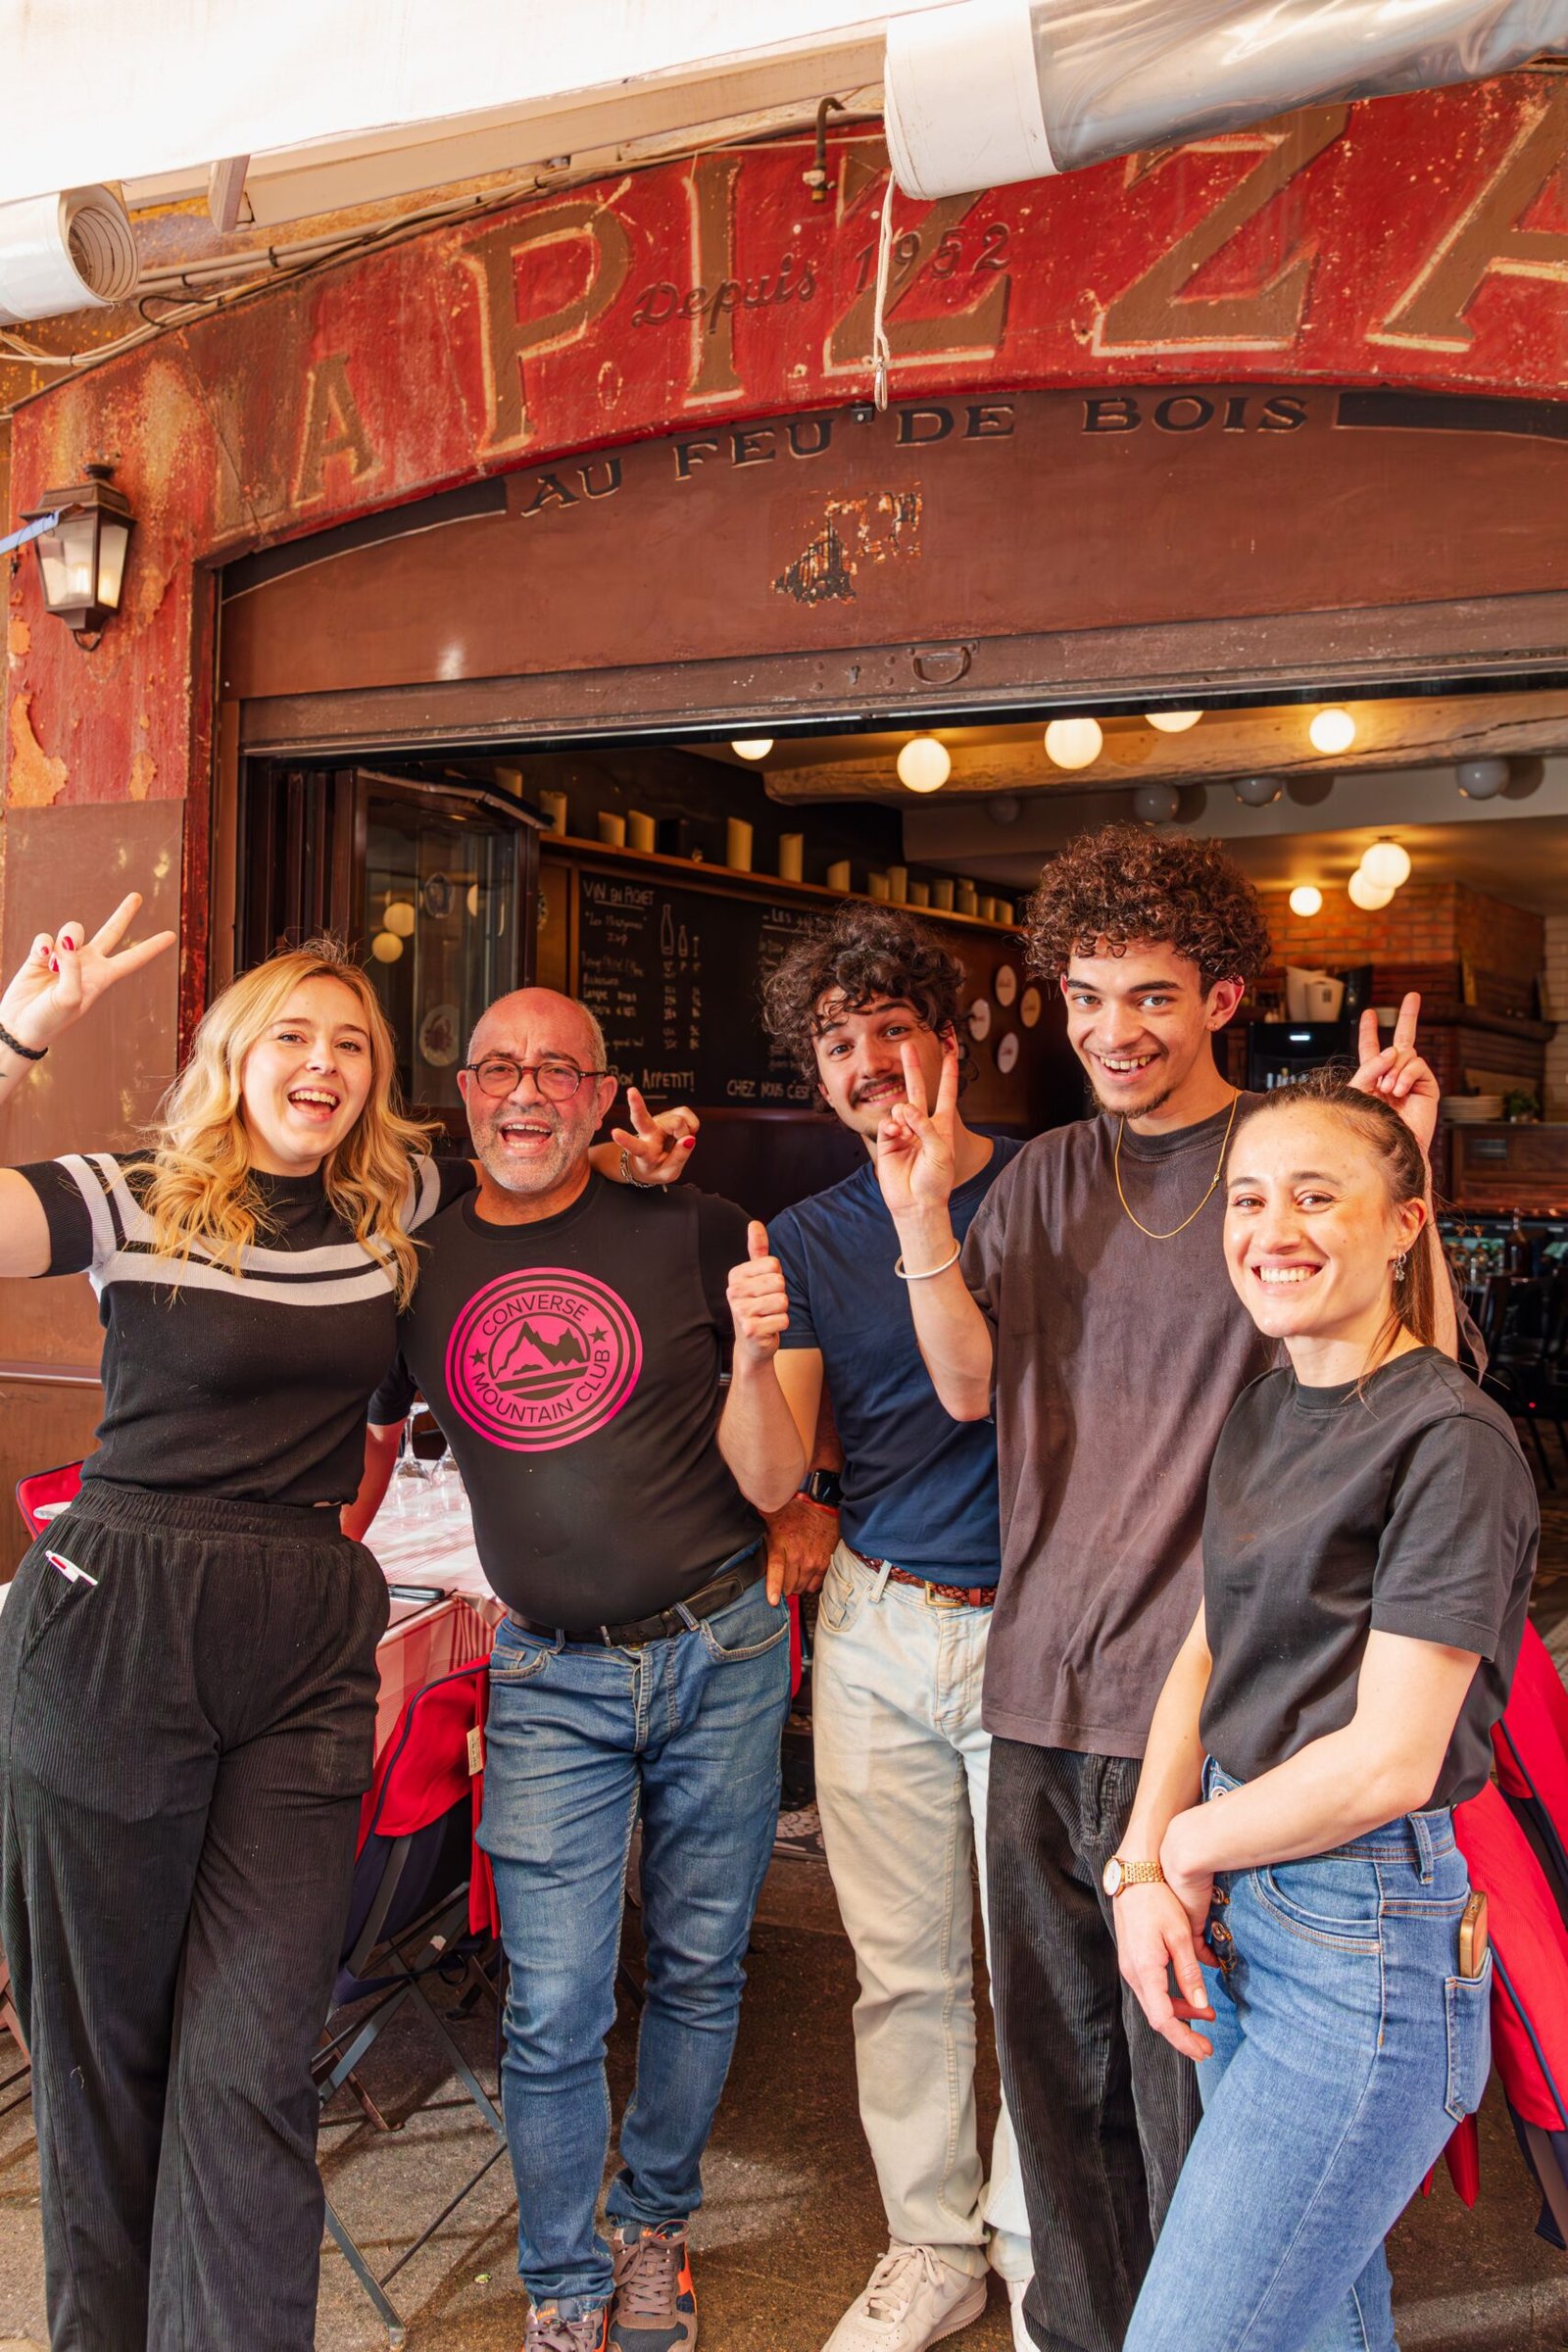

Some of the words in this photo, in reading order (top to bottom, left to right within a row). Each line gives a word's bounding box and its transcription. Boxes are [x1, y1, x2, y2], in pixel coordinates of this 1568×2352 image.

[631, 253, 817, 335] Depuis
[855, 221, 1011, 294] 1952
[520, 457, 623, 517] AU
[673, 417, 834, 482] FEU
[895, 403, 1016, 448] DE
[1082, 394, 1309, 435] BOIS
[481, 1294, 589, 1336] CONVERSE
[471, 1372, 575, 1423] MOUNTAIN
[575, 1348, 611, 1402] CLUB
